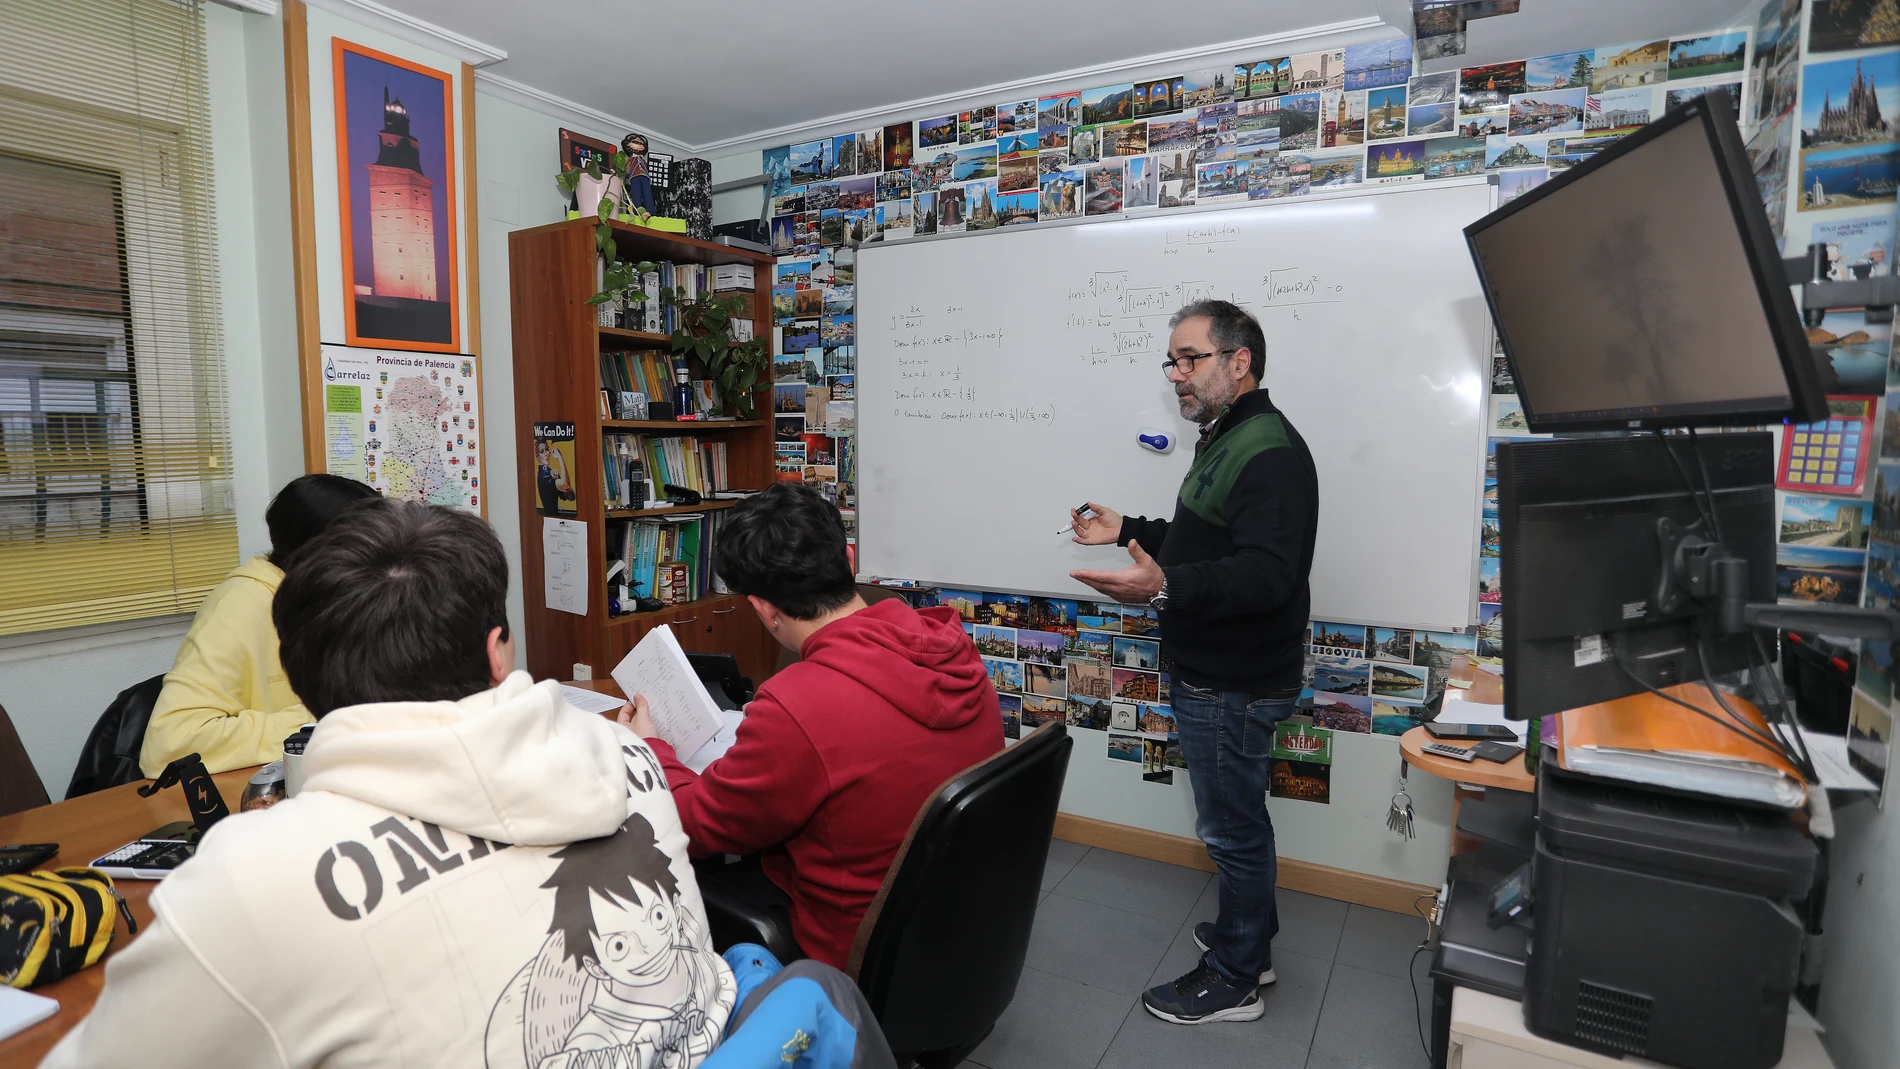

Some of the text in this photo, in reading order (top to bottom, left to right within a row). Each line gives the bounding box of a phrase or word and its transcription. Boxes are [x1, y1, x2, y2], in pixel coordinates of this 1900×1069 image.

[1351, 73, 1406, 88] TORONTO
[562, 130, 569, 140] 3
[1149, 143, 1196, 154] MARRAKECH
[376, 355, 456, 370] Provincia de Palencia
[623, 393, 645, 405] Math
[533, 424, 574, 438] We Can Do It!
[1193, 447, 1229, 502] 4
[1312, 645, 1364, 659] SEGOVIA
[315, 814, 514, 922] ON
